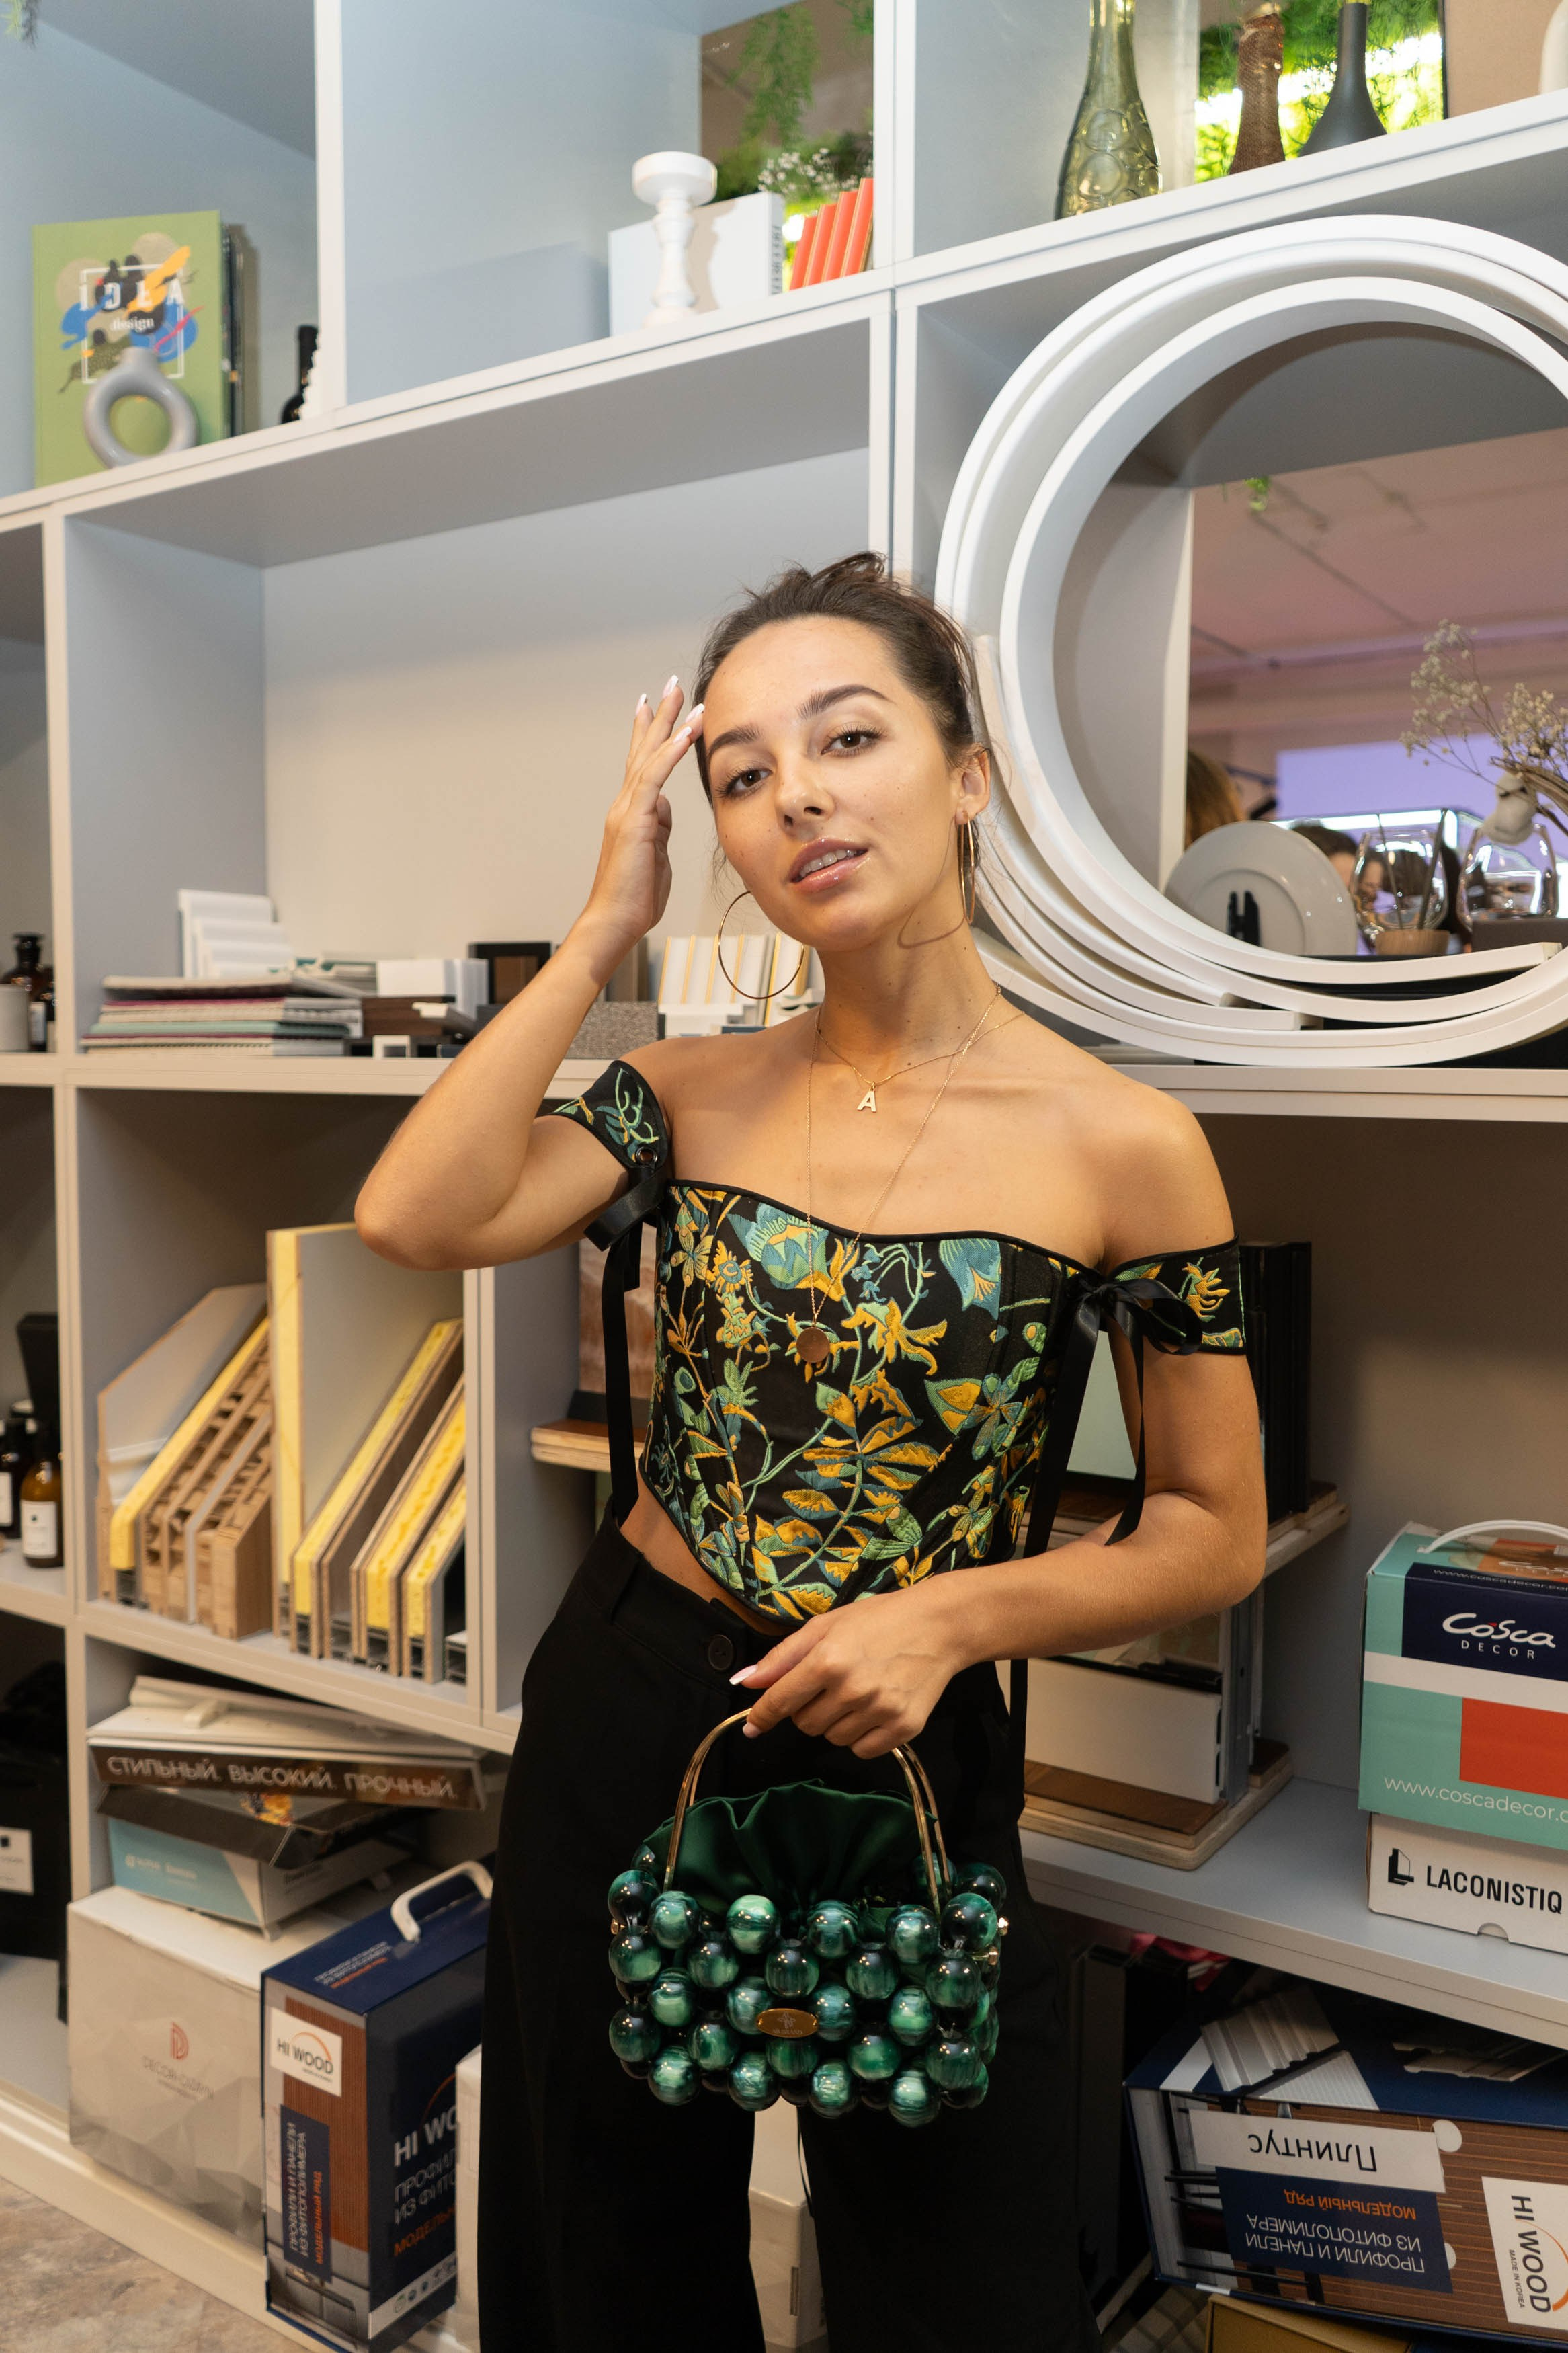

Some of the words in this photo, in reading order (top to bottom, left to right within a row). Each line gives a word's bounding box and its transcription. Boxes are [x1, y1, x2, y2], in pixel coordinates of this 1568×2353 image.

[1461, 1640, 1535, 1659] DECOR
[1427, 1865, 1563, 1915] LACONISTIQ
[276, 2038, 289, 2057] HI
[292, 2045, 334, 2075] WOOD
[394, 2130, 419, 2168] HI
[1247, 2129, 1377, 2172] Плинтус
[1283, 2189, 1315, 2207] РЯД
[1318, 2196, 1417, 2220] МОДЕЛЬНЫЙ
[1511, 2195, 1535, 2221] HI
[1247, 2213, 1391, 2247] ФИТОПОЛИМЕРА
[1395, 2235, 1421, 2252] ИЗ
[1245, 2233, 1314, 2257] ПАНЕЛИ
[1318, 2243, 1331, 2259] И
[1335, 2246, 1425, 2273] ПРОФИЛИ
[1518, 2231, 1551, 2313] WOOD
[1510, 2249, 1519, 2272] MADE
[1516, 2282, 1526, 2309] KOREA
